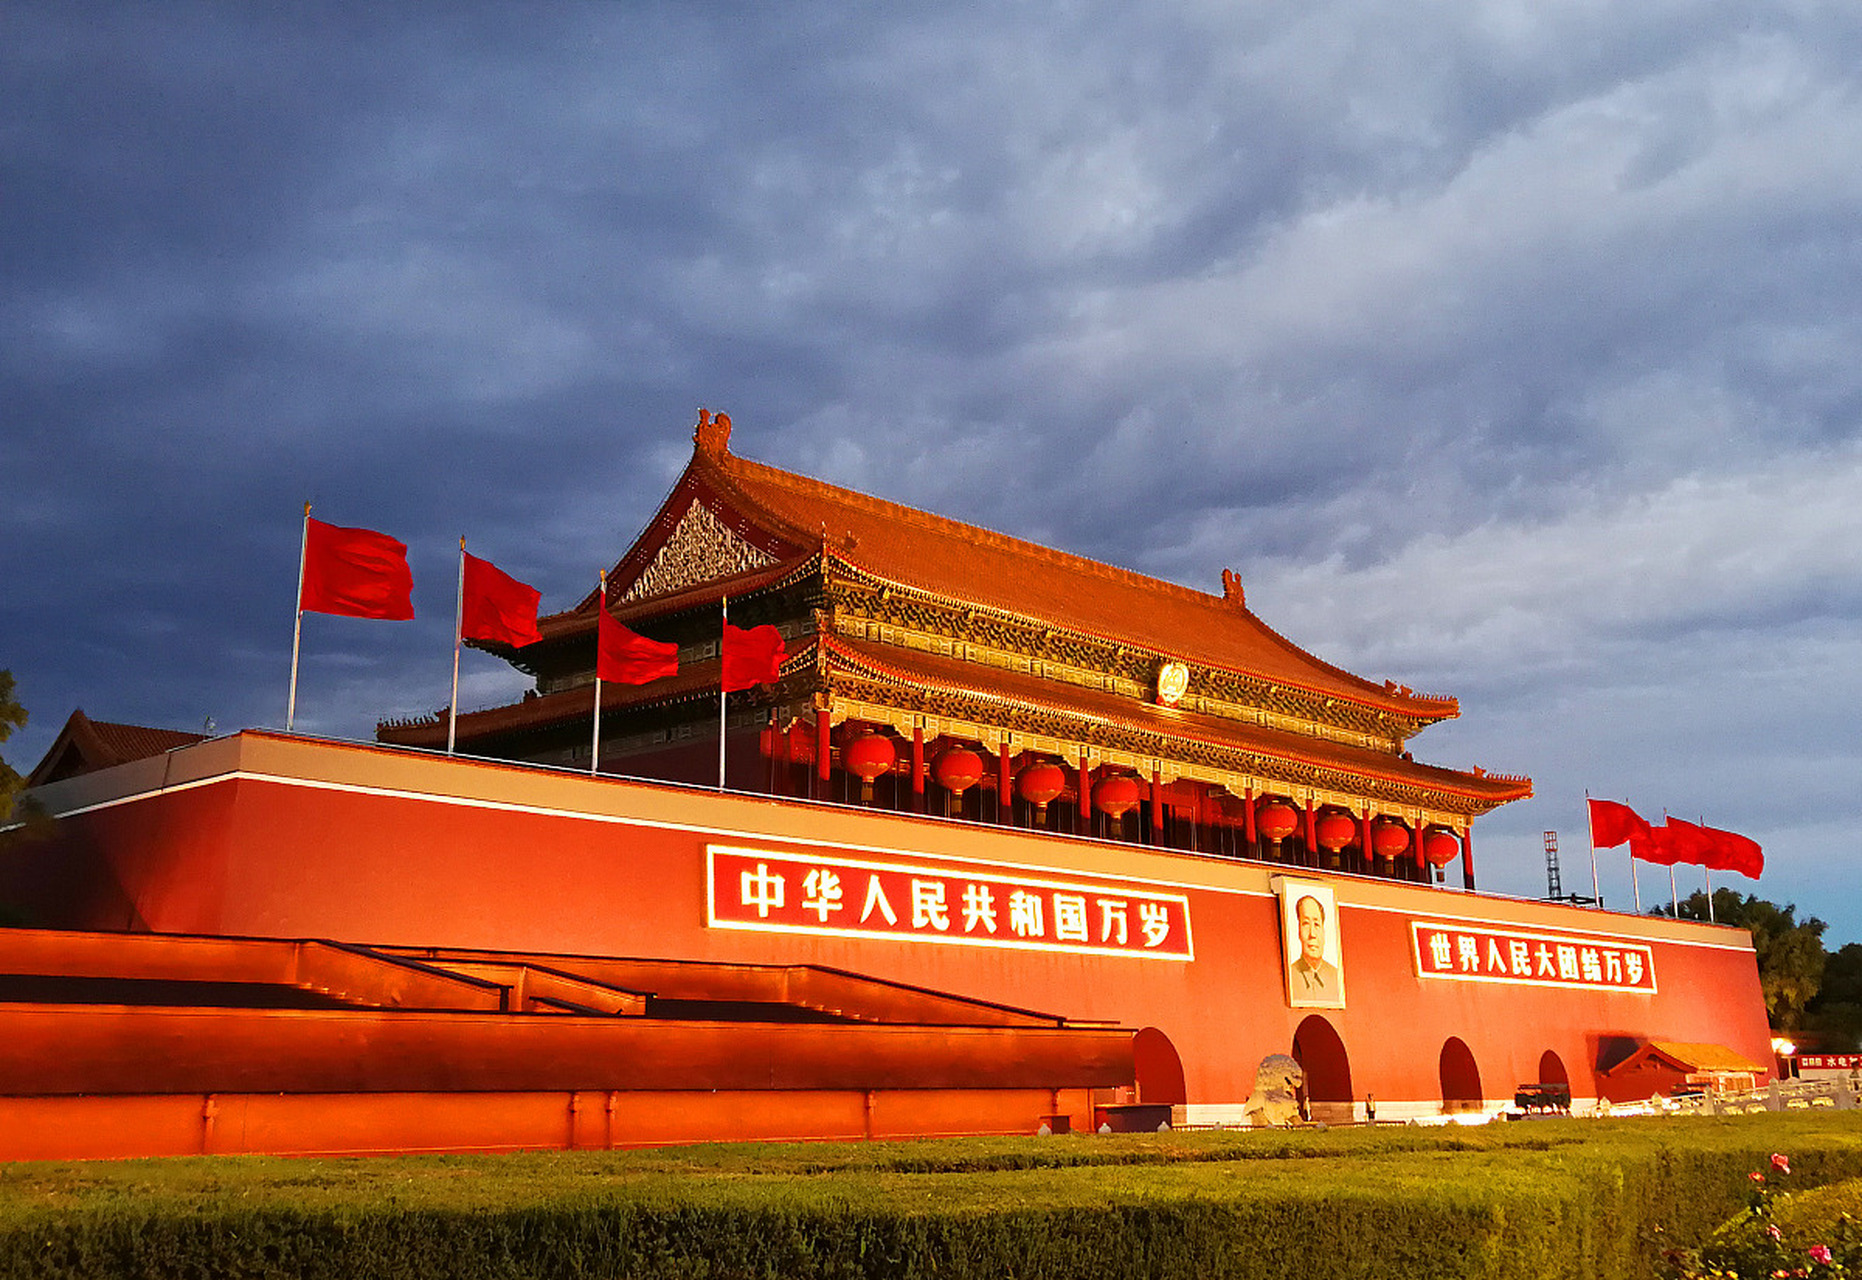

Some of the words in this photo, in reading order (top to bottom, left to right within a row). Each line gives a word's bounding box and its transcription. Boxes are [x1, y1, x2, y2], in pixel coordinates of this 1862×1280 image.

[740, 863, 1170, 947] 中华人民共和国万岁
[1429, 932, 1644, 985] 世界人民大团结万岁
